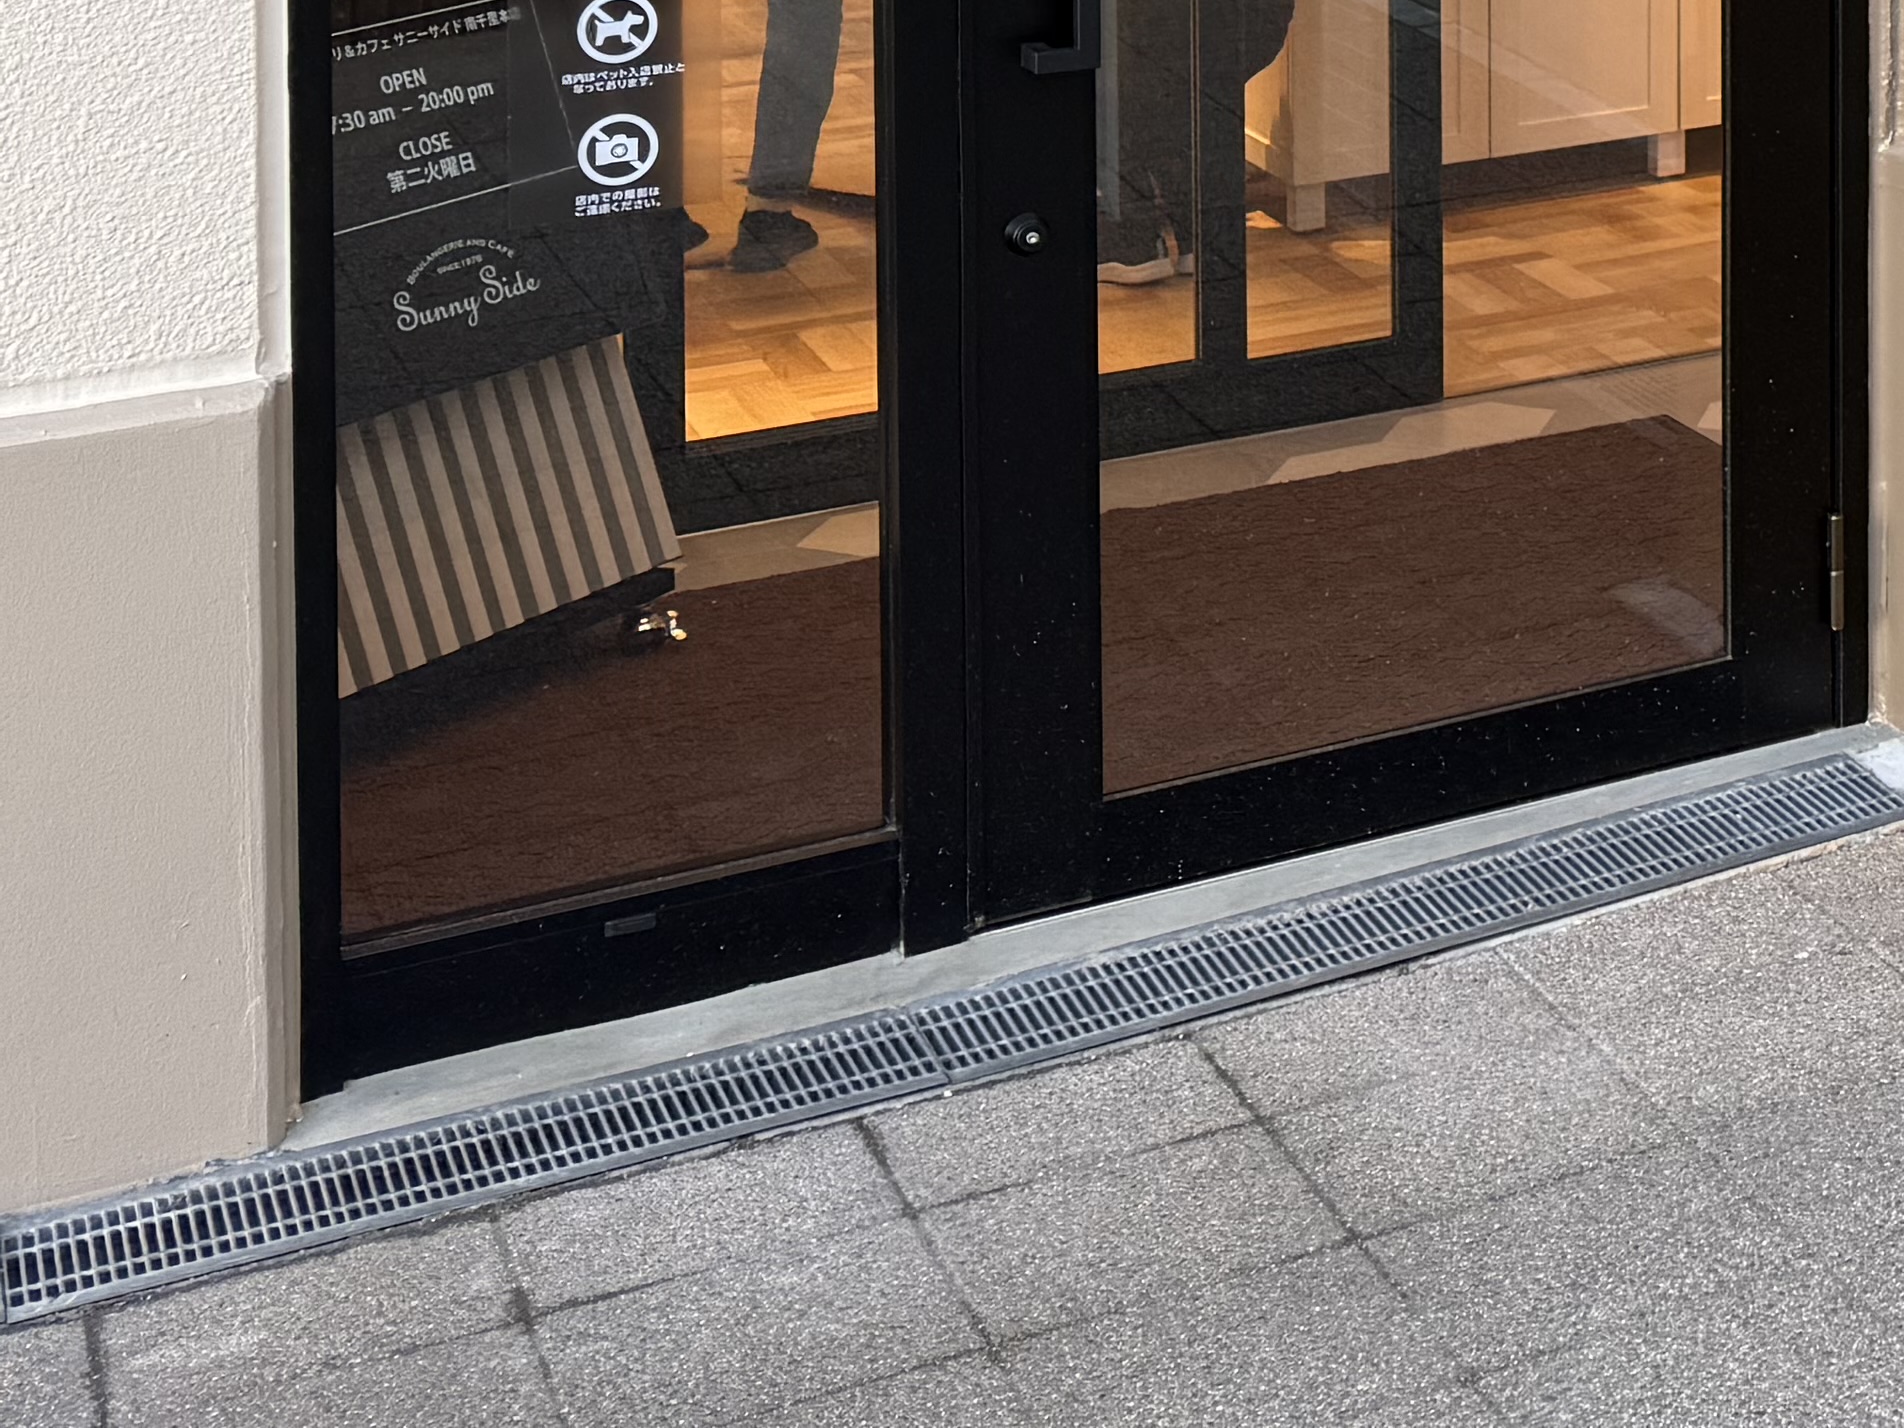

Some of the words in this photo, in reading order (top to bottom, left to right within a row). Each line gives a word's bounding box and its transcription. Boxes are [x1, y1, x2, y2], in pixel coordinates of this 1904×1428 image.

[380, 67, 427, 94] OPEN
[368, 106, 396, 126] am
[418, 85, 464, 113] 20:00
[467, 82, 494, 105] pm
[399, 131, 453, 161] CLOSE
[386, 151, 477, 194] 第二火曜日
[393, 291, 481, 331] Sunny
[479, 264, 541, 304] Side
